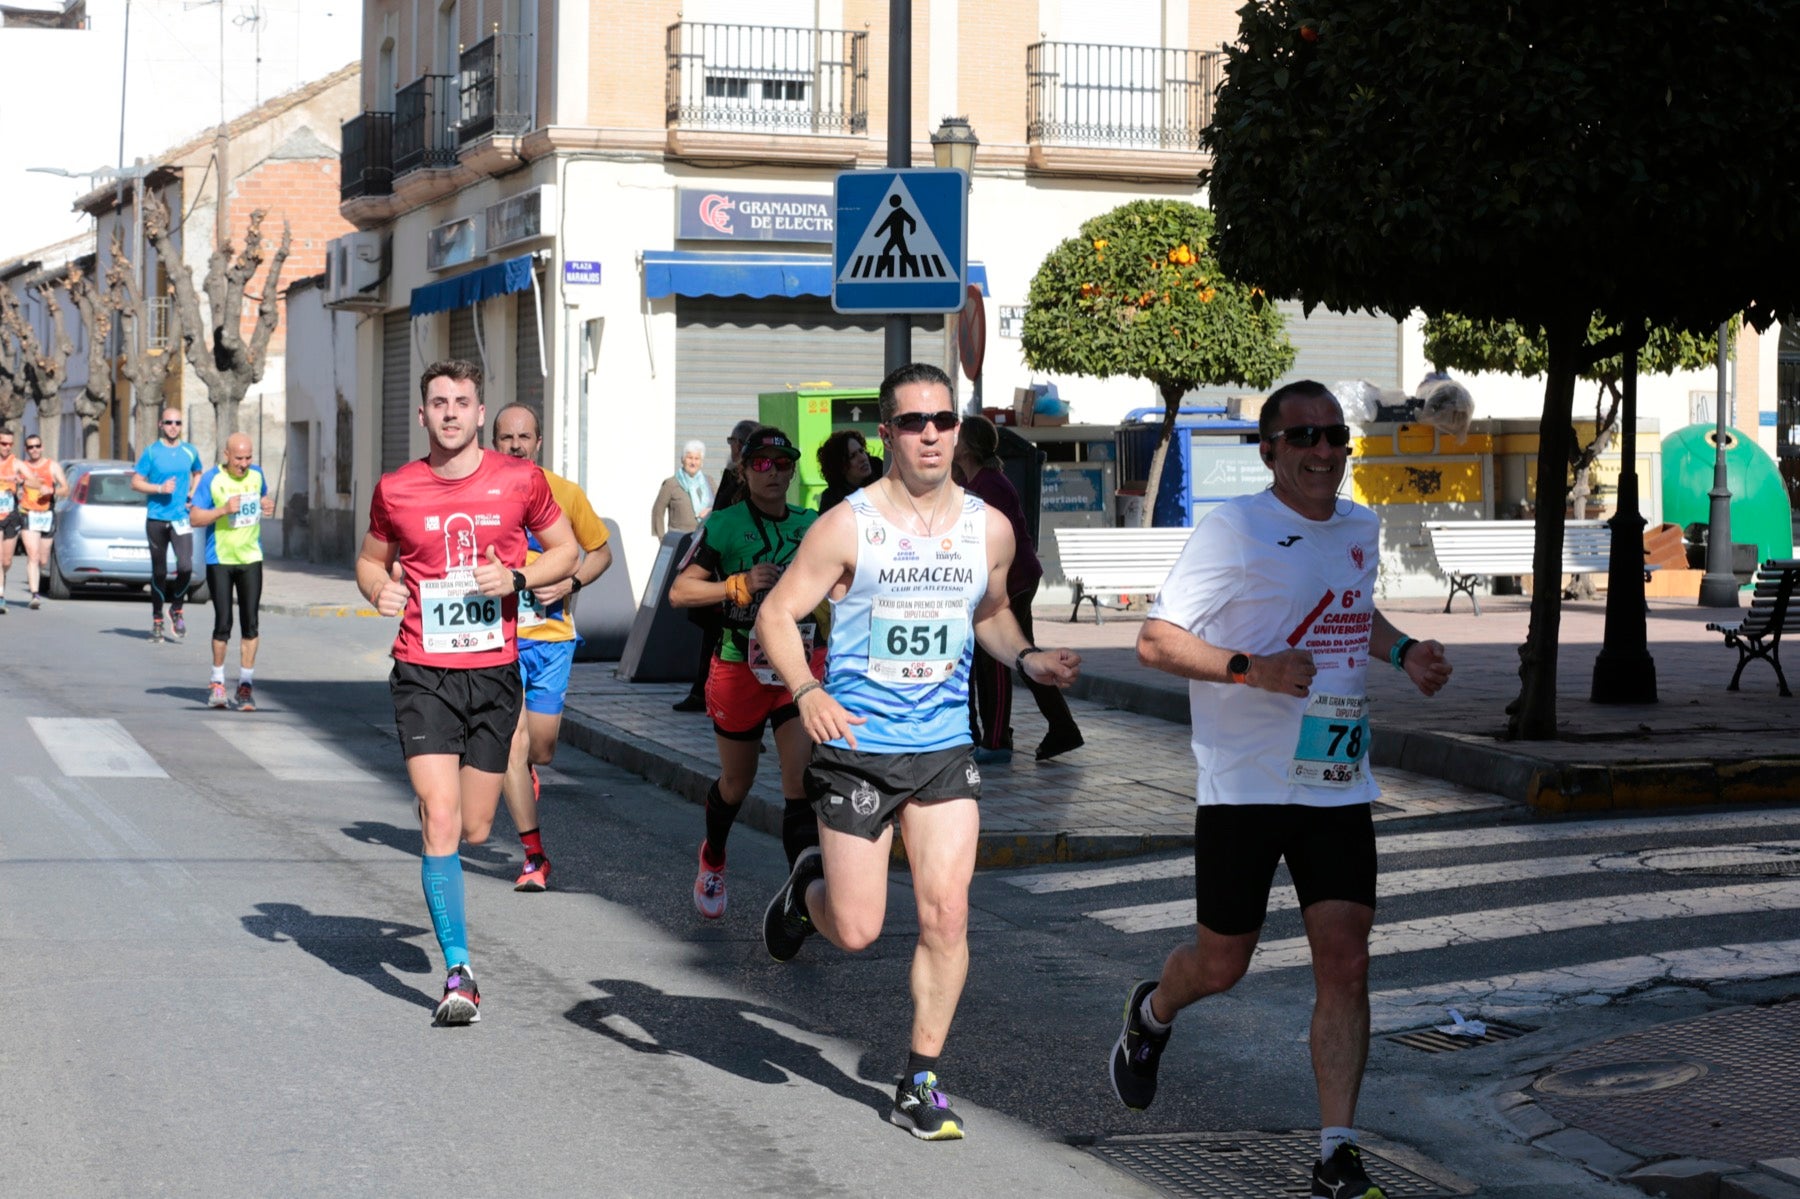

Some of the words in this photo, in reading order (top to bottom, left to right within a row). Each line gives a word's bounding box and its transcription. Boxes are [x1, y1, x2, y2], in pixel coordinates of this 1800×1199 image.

[739, 201, 828, 216] GRANADINA
[751, 216, 772, 229] DE
[775, 217, 833, 231] ELECTR
[572, 262, 592, 270] PLAZA
[566, 272, 600, 282] NARANJOS
[236, 502, 257, 516] 68
[878, 567, 973, 584] MARACENA
[441, 581, 454, 589] GRAN
[455, 580, 474, 588] PREMIO
[924, 585, 964, 593] ATLETISMO
[896, 600, 912, 609] GRAN
[914, 601, 935, 609] PREMIO
[936, 601, 944, 609] DE
[945, 600, 963, 608] FONDO
[433, 600, 496, 626] 1206
[887, 625, 948, 655] 651
[1329, 697, 1345, 706] GRAN
[1327, 725, 1362, 758] 78
